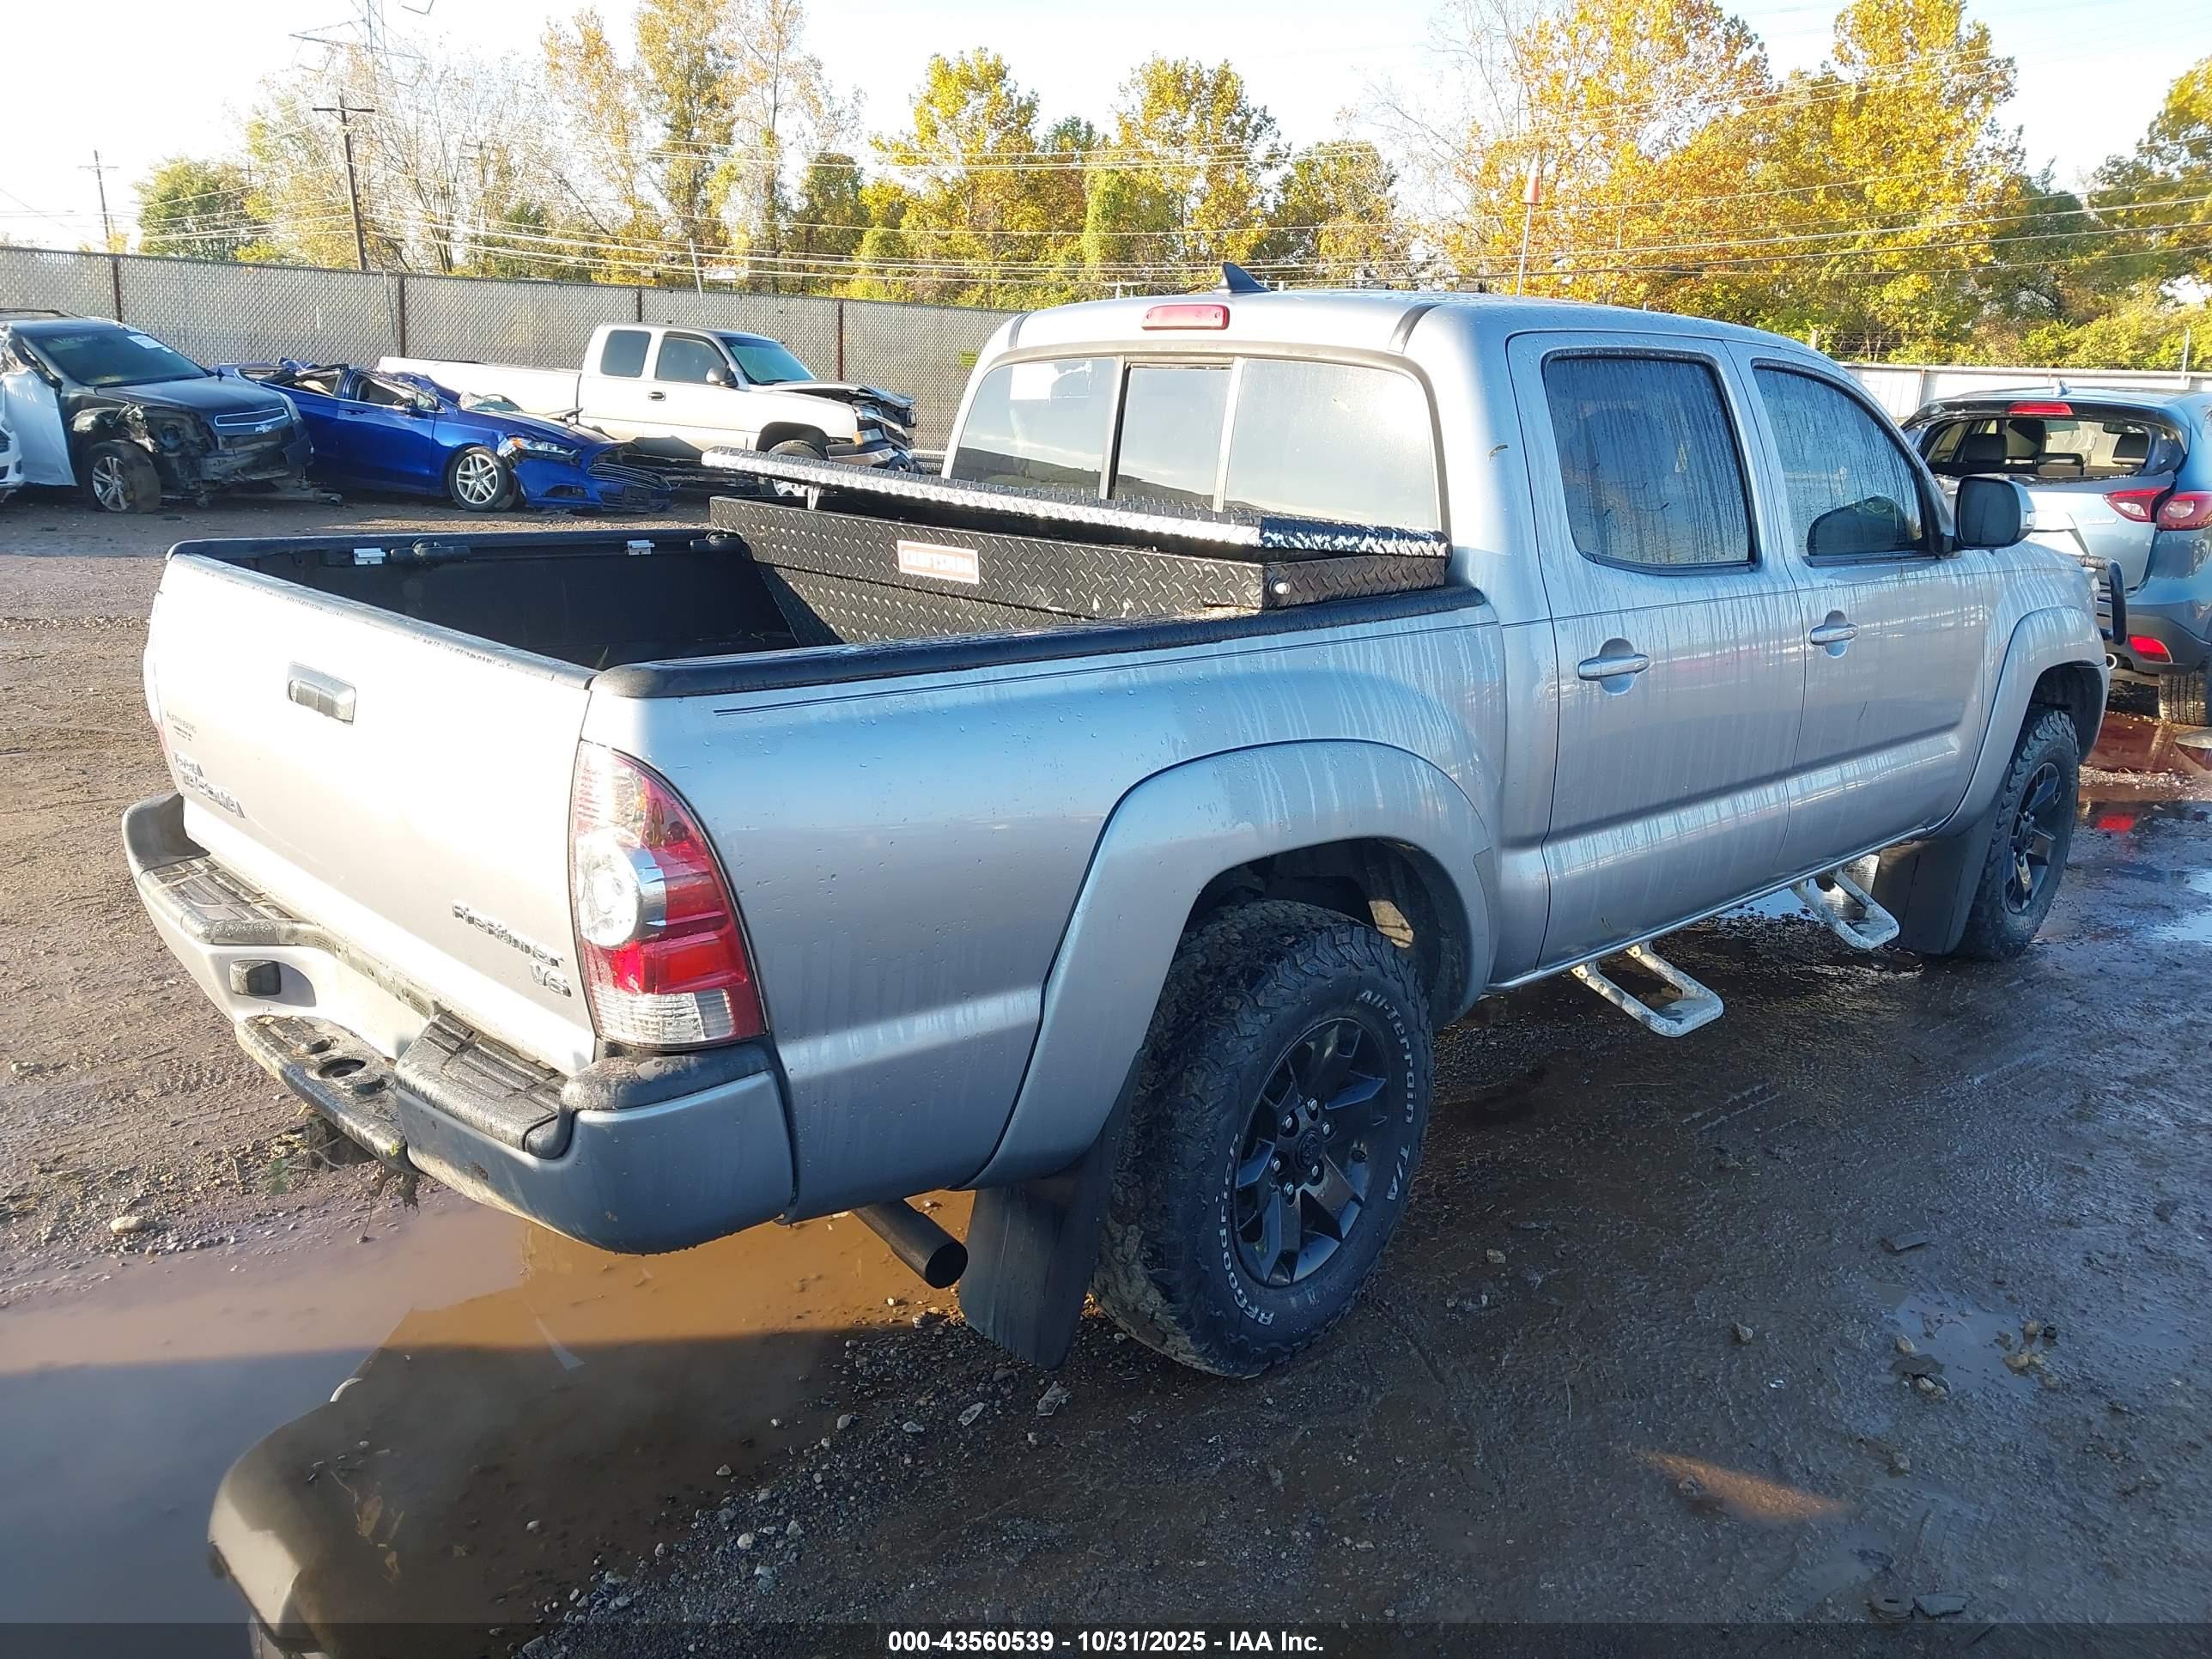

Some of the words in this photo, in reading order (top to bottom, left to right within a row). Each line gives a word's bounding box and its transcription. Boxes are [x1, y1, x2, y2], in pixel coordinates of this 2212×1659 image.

[529, 963, 572, 997] V6
[1354, 989, 1417, 1124] All-Terrain
[1386, 1144, 1411, 1200] T/A
